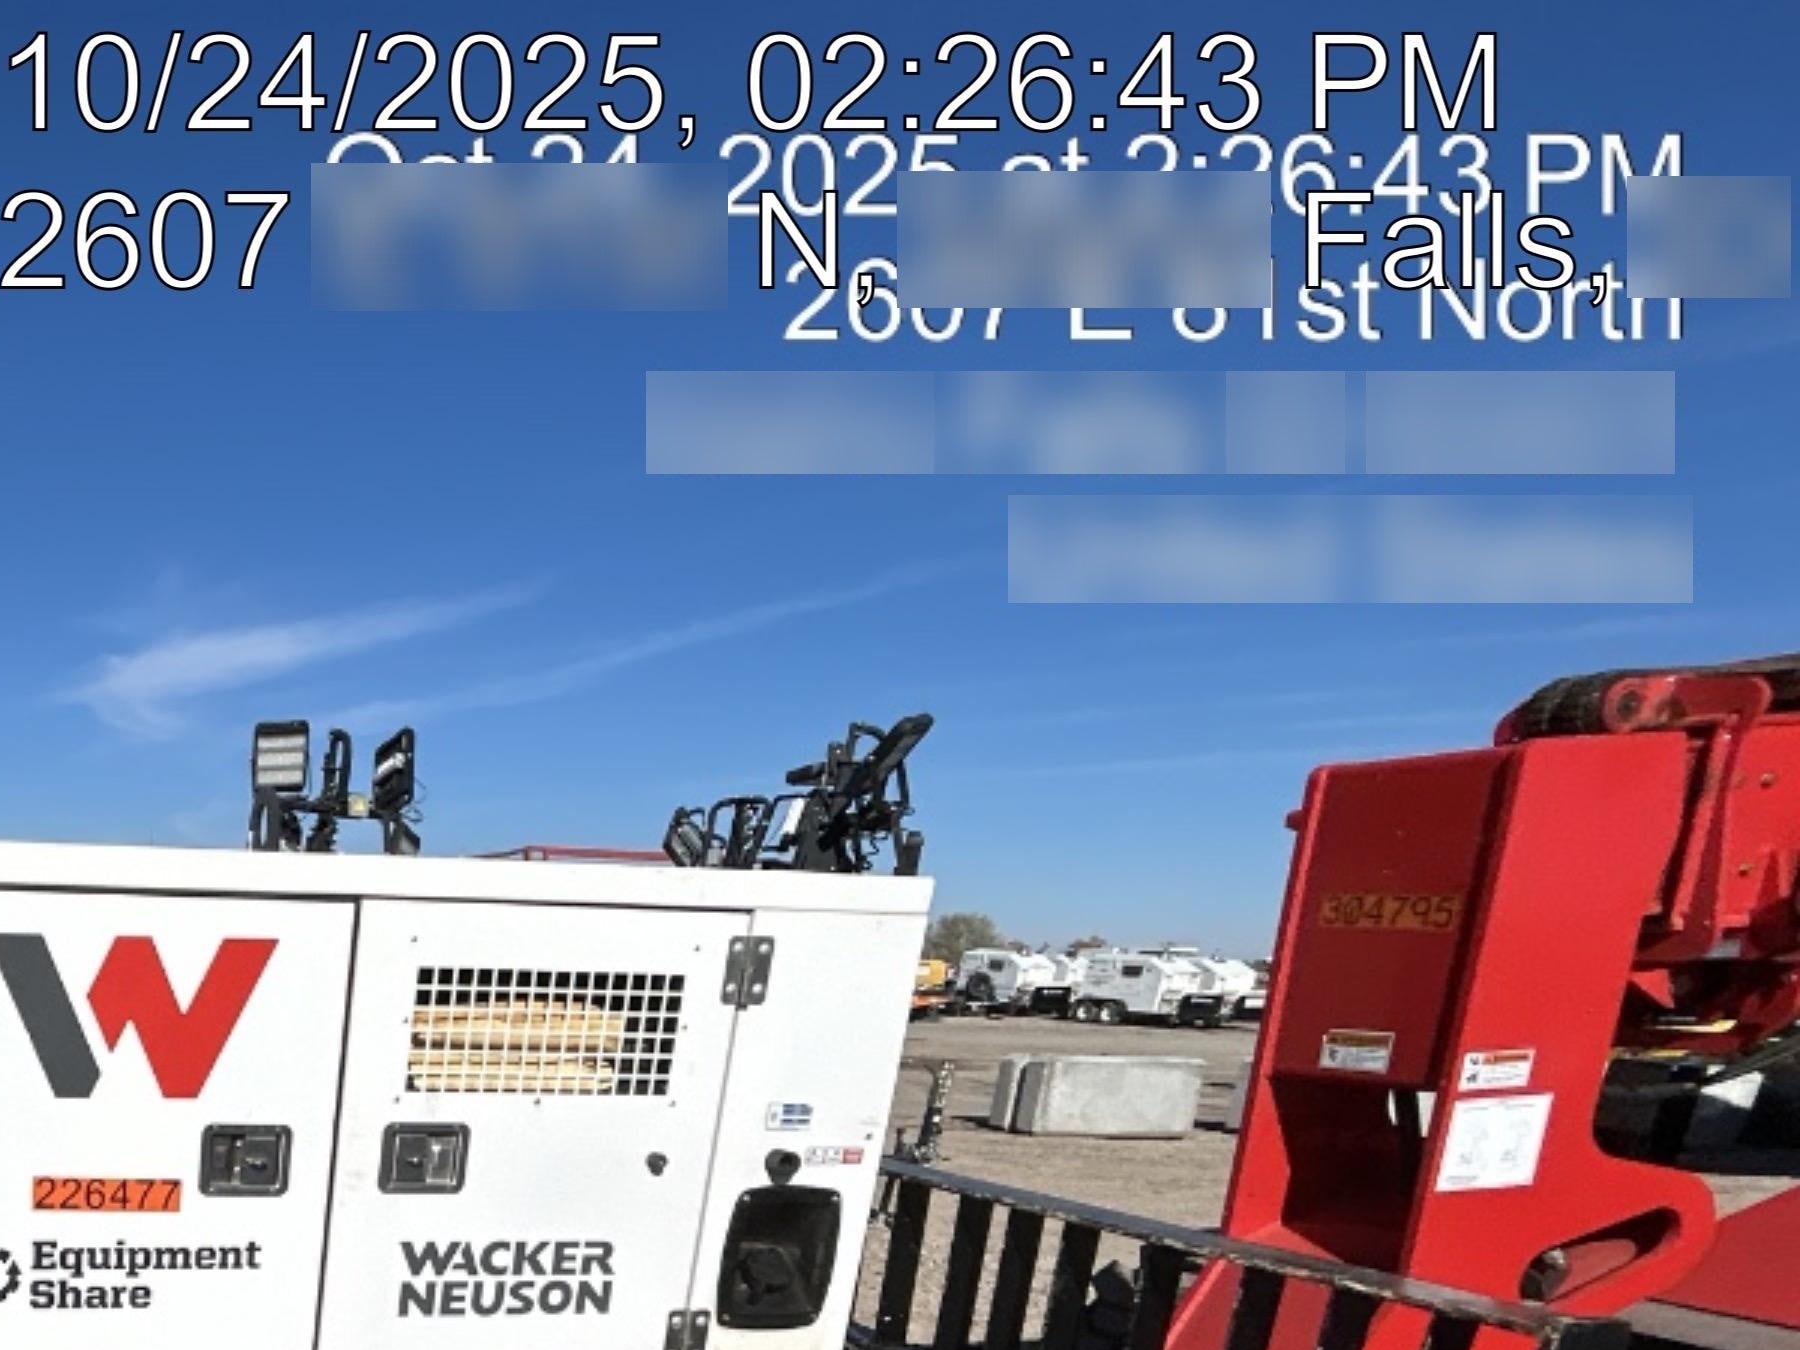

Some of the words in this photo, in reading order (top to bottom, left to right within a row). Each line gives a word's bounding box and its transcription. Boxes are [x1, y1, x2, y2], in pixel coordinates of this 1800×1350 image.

[33, 1178, 181, 1211] 226477
[31, 1240, 261, 1278] Equipment
[399, 1241, 615, 1276] WACKER
[30, 1280, 152, 1309] Share
[398, 1280, 613, 1317] NEUSON
